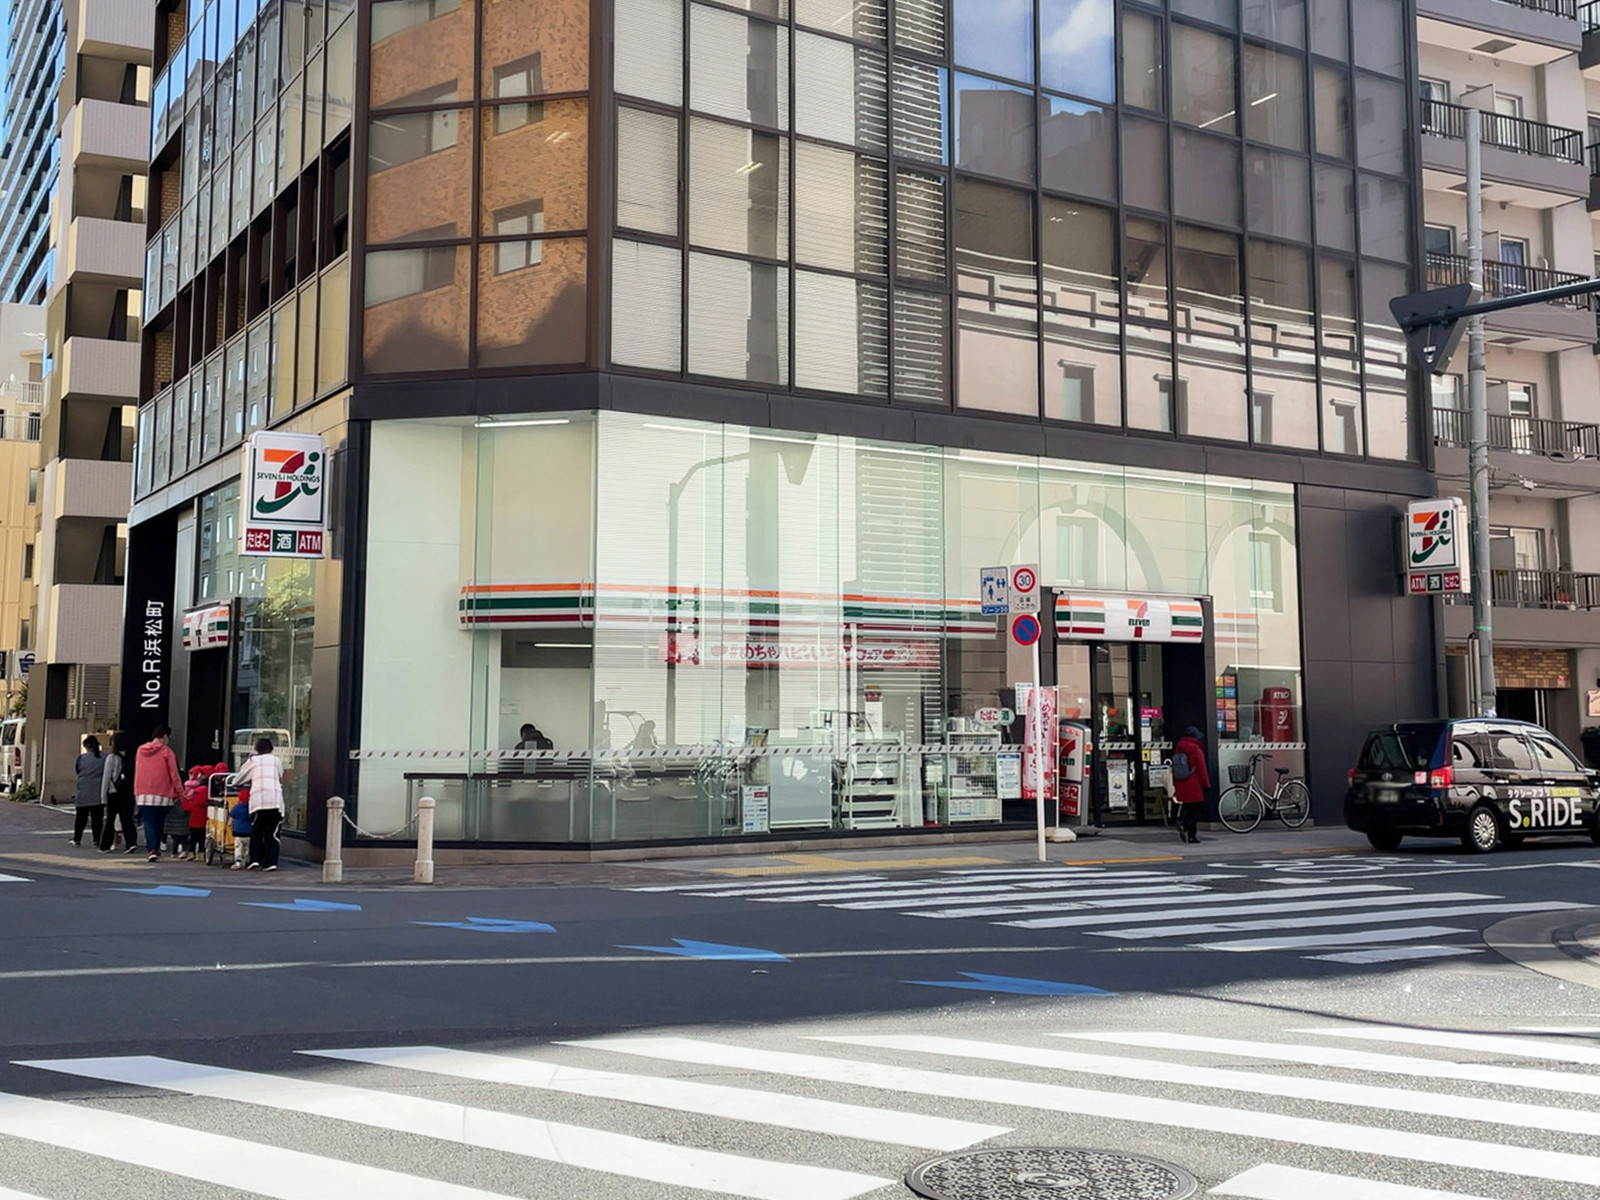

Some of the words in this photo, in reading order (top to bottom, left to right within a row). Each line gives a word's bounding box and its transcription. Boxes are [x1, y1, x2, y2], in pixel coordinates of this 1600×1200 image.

[256, 472, 277, 480] SEVEN
[286, 474, 320, 483] HOLDINGS
[247, 532, 270, 548] たばこ
[276, 534, 292, 549] 酒
[299, 535, 321, 550] ATM
[1018, 575, 1031, 586] 30
[1412, 577, 1426, 590] ATM
[980, 710, 998, 720] たばこ
[1508, 788, 1551, 799] タクシーアプリ
[1509, 797, 1583, 829] S.RIDE
